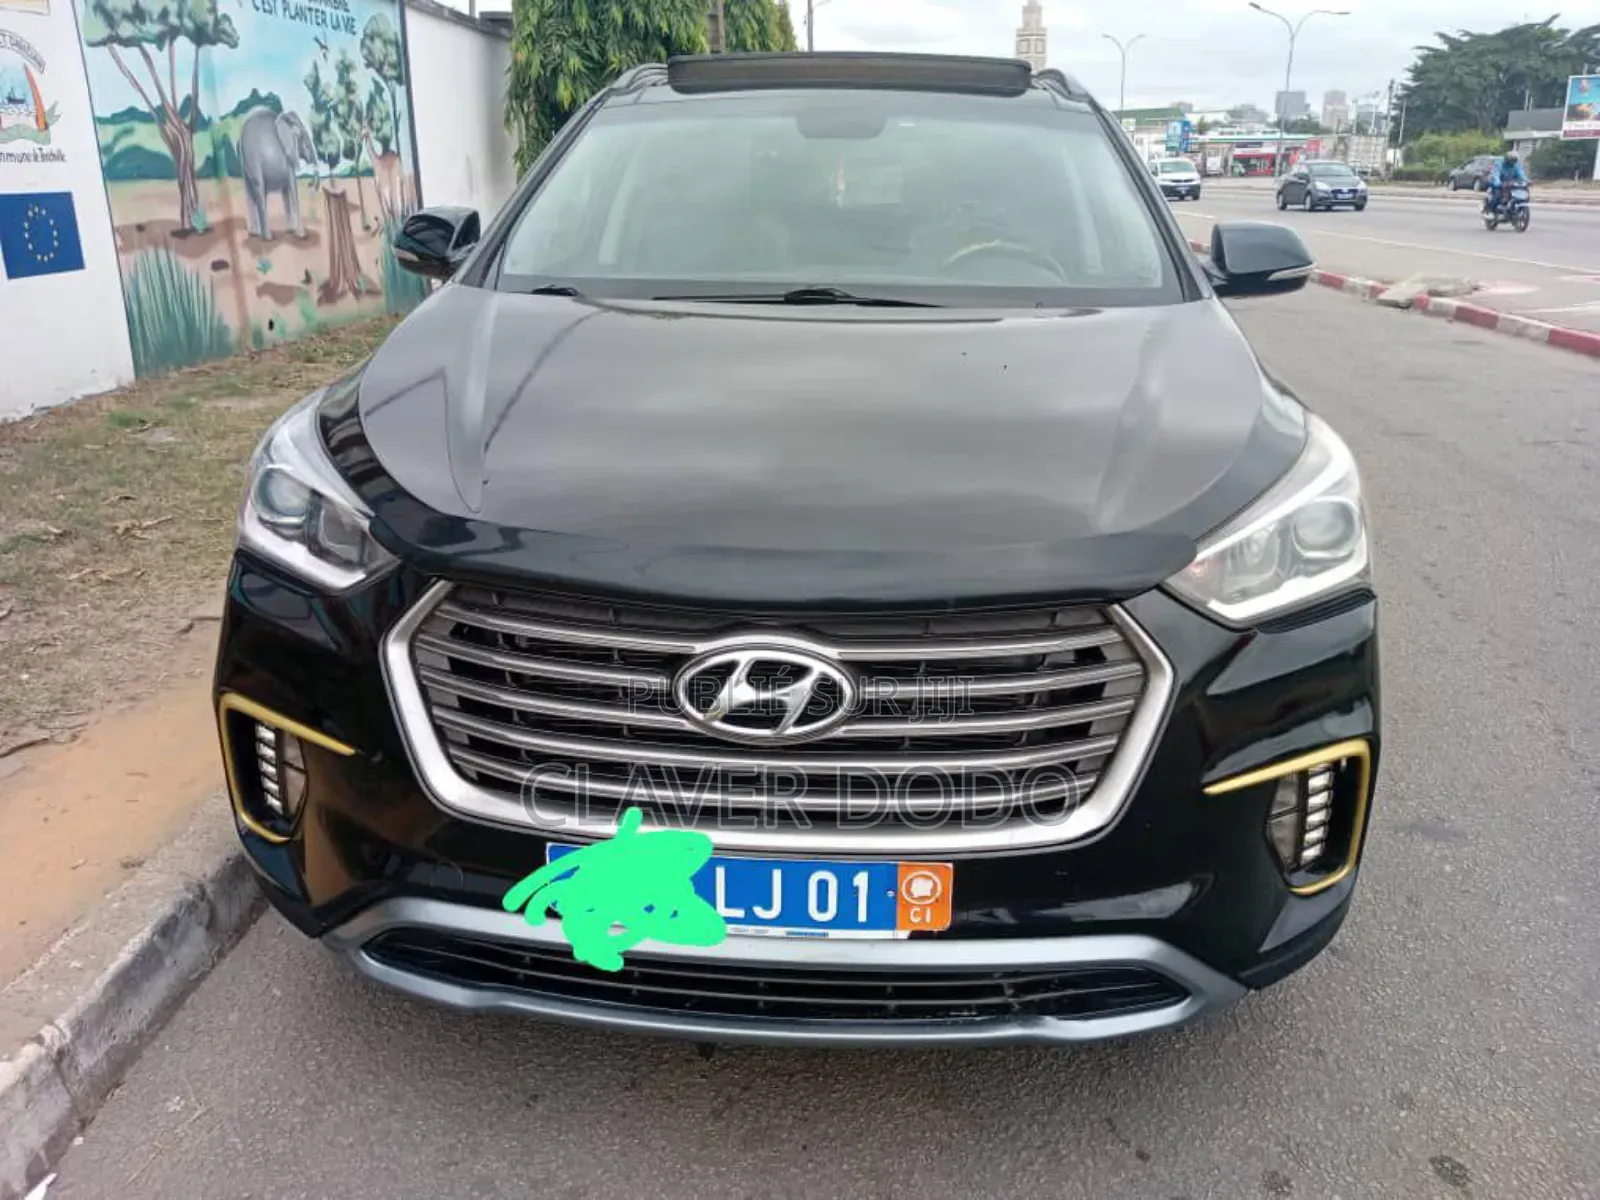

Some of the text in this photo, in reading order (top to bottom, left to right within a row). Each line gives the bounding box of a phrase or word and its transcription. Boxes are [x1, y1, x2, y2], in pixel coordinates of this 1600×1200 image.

[280, 0, 328, 28] PLANTER
[342, 14, 356, 36] VIE
[715, 866, 869, 923] LJ 01
[909, 907, 932, 924] CI
